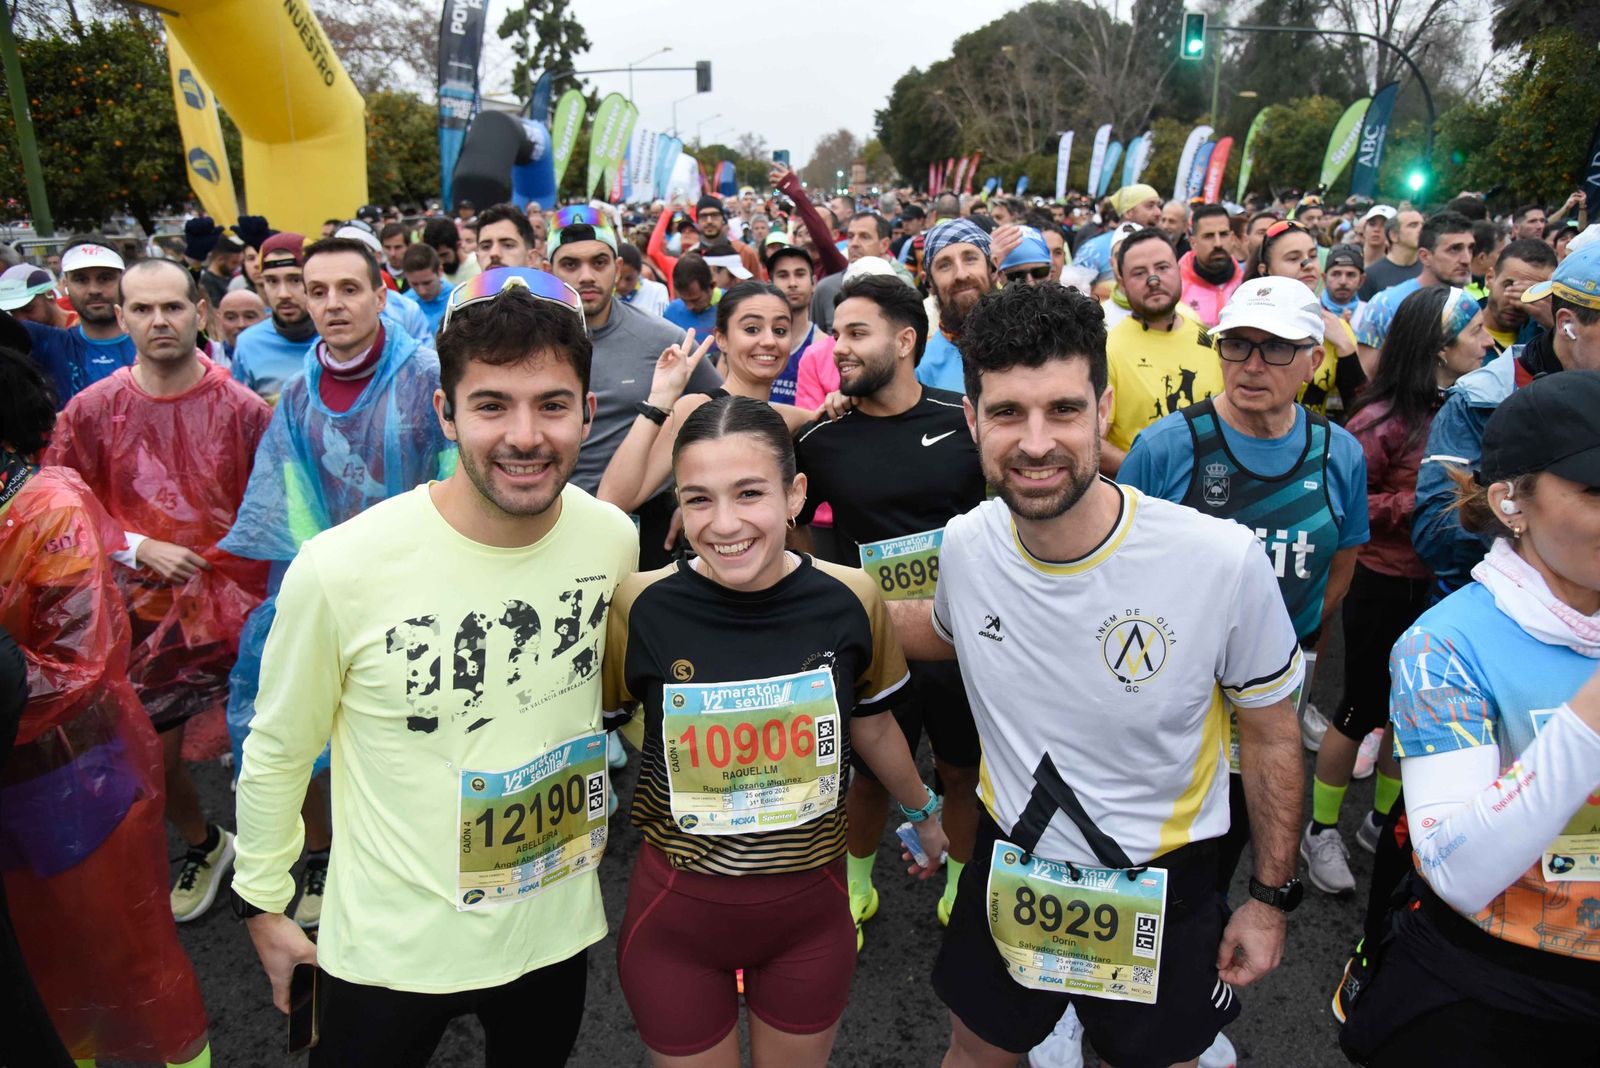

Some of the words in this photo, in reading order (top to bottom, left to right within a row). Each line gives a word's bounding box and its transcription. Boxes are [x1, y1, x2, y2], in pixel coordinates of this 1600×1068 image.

[283, 0, 335, 87] NUESTRO
[1358, 125, 1380, 167] ABC
[342, 462, 365, 485] 43
[156, 487, 177, 511] 43
[575, 574, 607, 584] KIPRUN
[878, 555, 939, 592] 8698
[1125, 608, 1140, 616] DE
[978, 631, 1003, 642] asioka
[717, 683, 781, 699] maratón
[1124, 685, 1139, 693] GC
[530, 692, 558, 709] VALENCIA
[735, 692, 781, 709] sevilla
[679, 714, 815, 769] 10906
[520, 750, 562, 776] maratón
[531, 758, 563, 782] sevilla
[722, 766, 762, 781] RAQUEL
[764, 765, 779, 775] LM
[703, 785, 732, 794] Raquel
[733, 781, 765, 791] Lozano
[745, 791, 753, 799] 25
[754, 789, 773, 798] enero
[774, 787, 790, 795] 2026
[476, 774, 585, 847] 12190
[730, 816, 757, 826] HOKA
[762, 813, 793, 822] Sprinter
[516, 829, 558, 854] ABELLEIRA
[517, 881, 540, 895] HOKA
[1013, 886, 1119, 942] 8929
[1018, 940, 1055, 955] Salvador
[1056, 949, 1090, 961] Climent
[1090, 955, 1112, 964] Haro
[1038, 976, 1063, 985] HOKA
[1068, 980, 1100, 990] Sprinter
